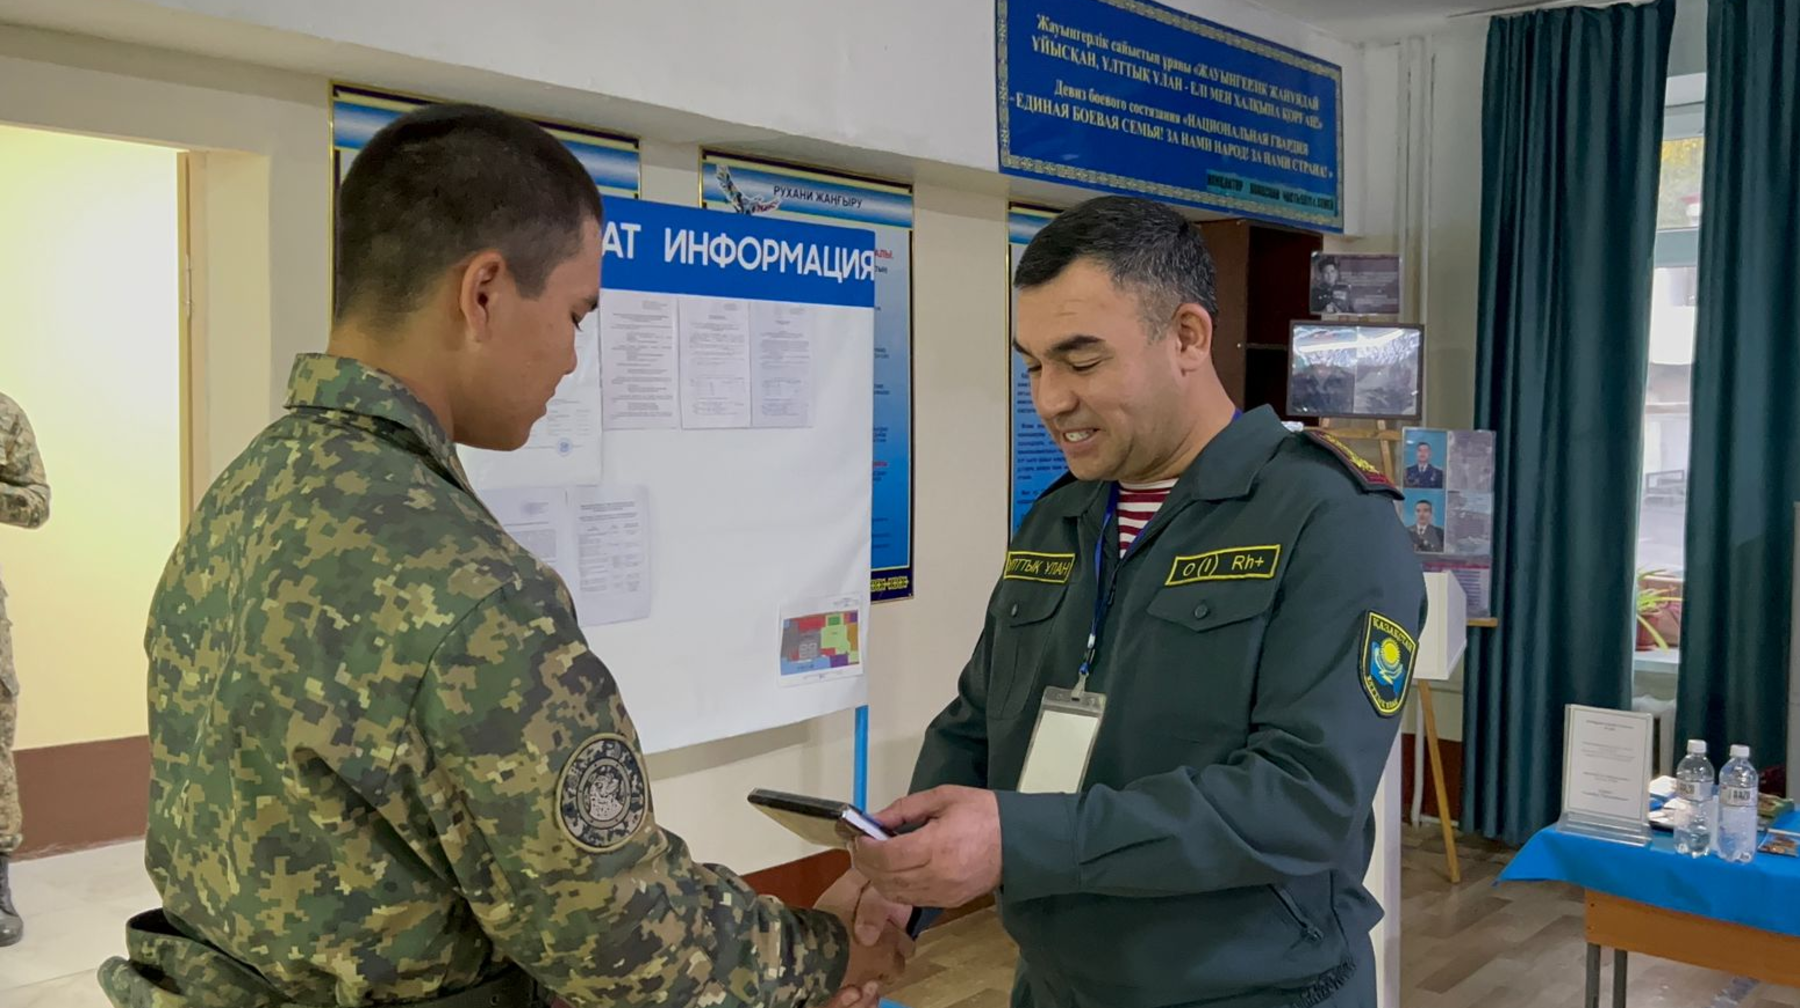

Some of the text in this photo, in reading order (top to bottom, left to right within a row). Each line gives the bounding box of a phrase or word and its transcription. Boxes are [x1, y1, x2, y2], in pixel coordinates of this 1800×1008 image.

[1054, 79, 1086, 100] Девиз
[1088, 88, 1126, 111] боевого
[1015, 92, 1070, 119] ЕДИНАЯ
[1072, 105, 1119, 131] БОЕВАЯ
[1121, 117, 1164, 141] СЕМЬЯ!
[1167, 130, 1179, 144] ЗА
[1181, 132, 1212, 152] НАМИ
[1251, 150, 1263, 164] ЗА
[773, 185, 813, 201] РУХАНИ
[664, 226, 875, 284] ИНФОРМАЦИЯ
[1231, 554, 1264, 571] Rh+
